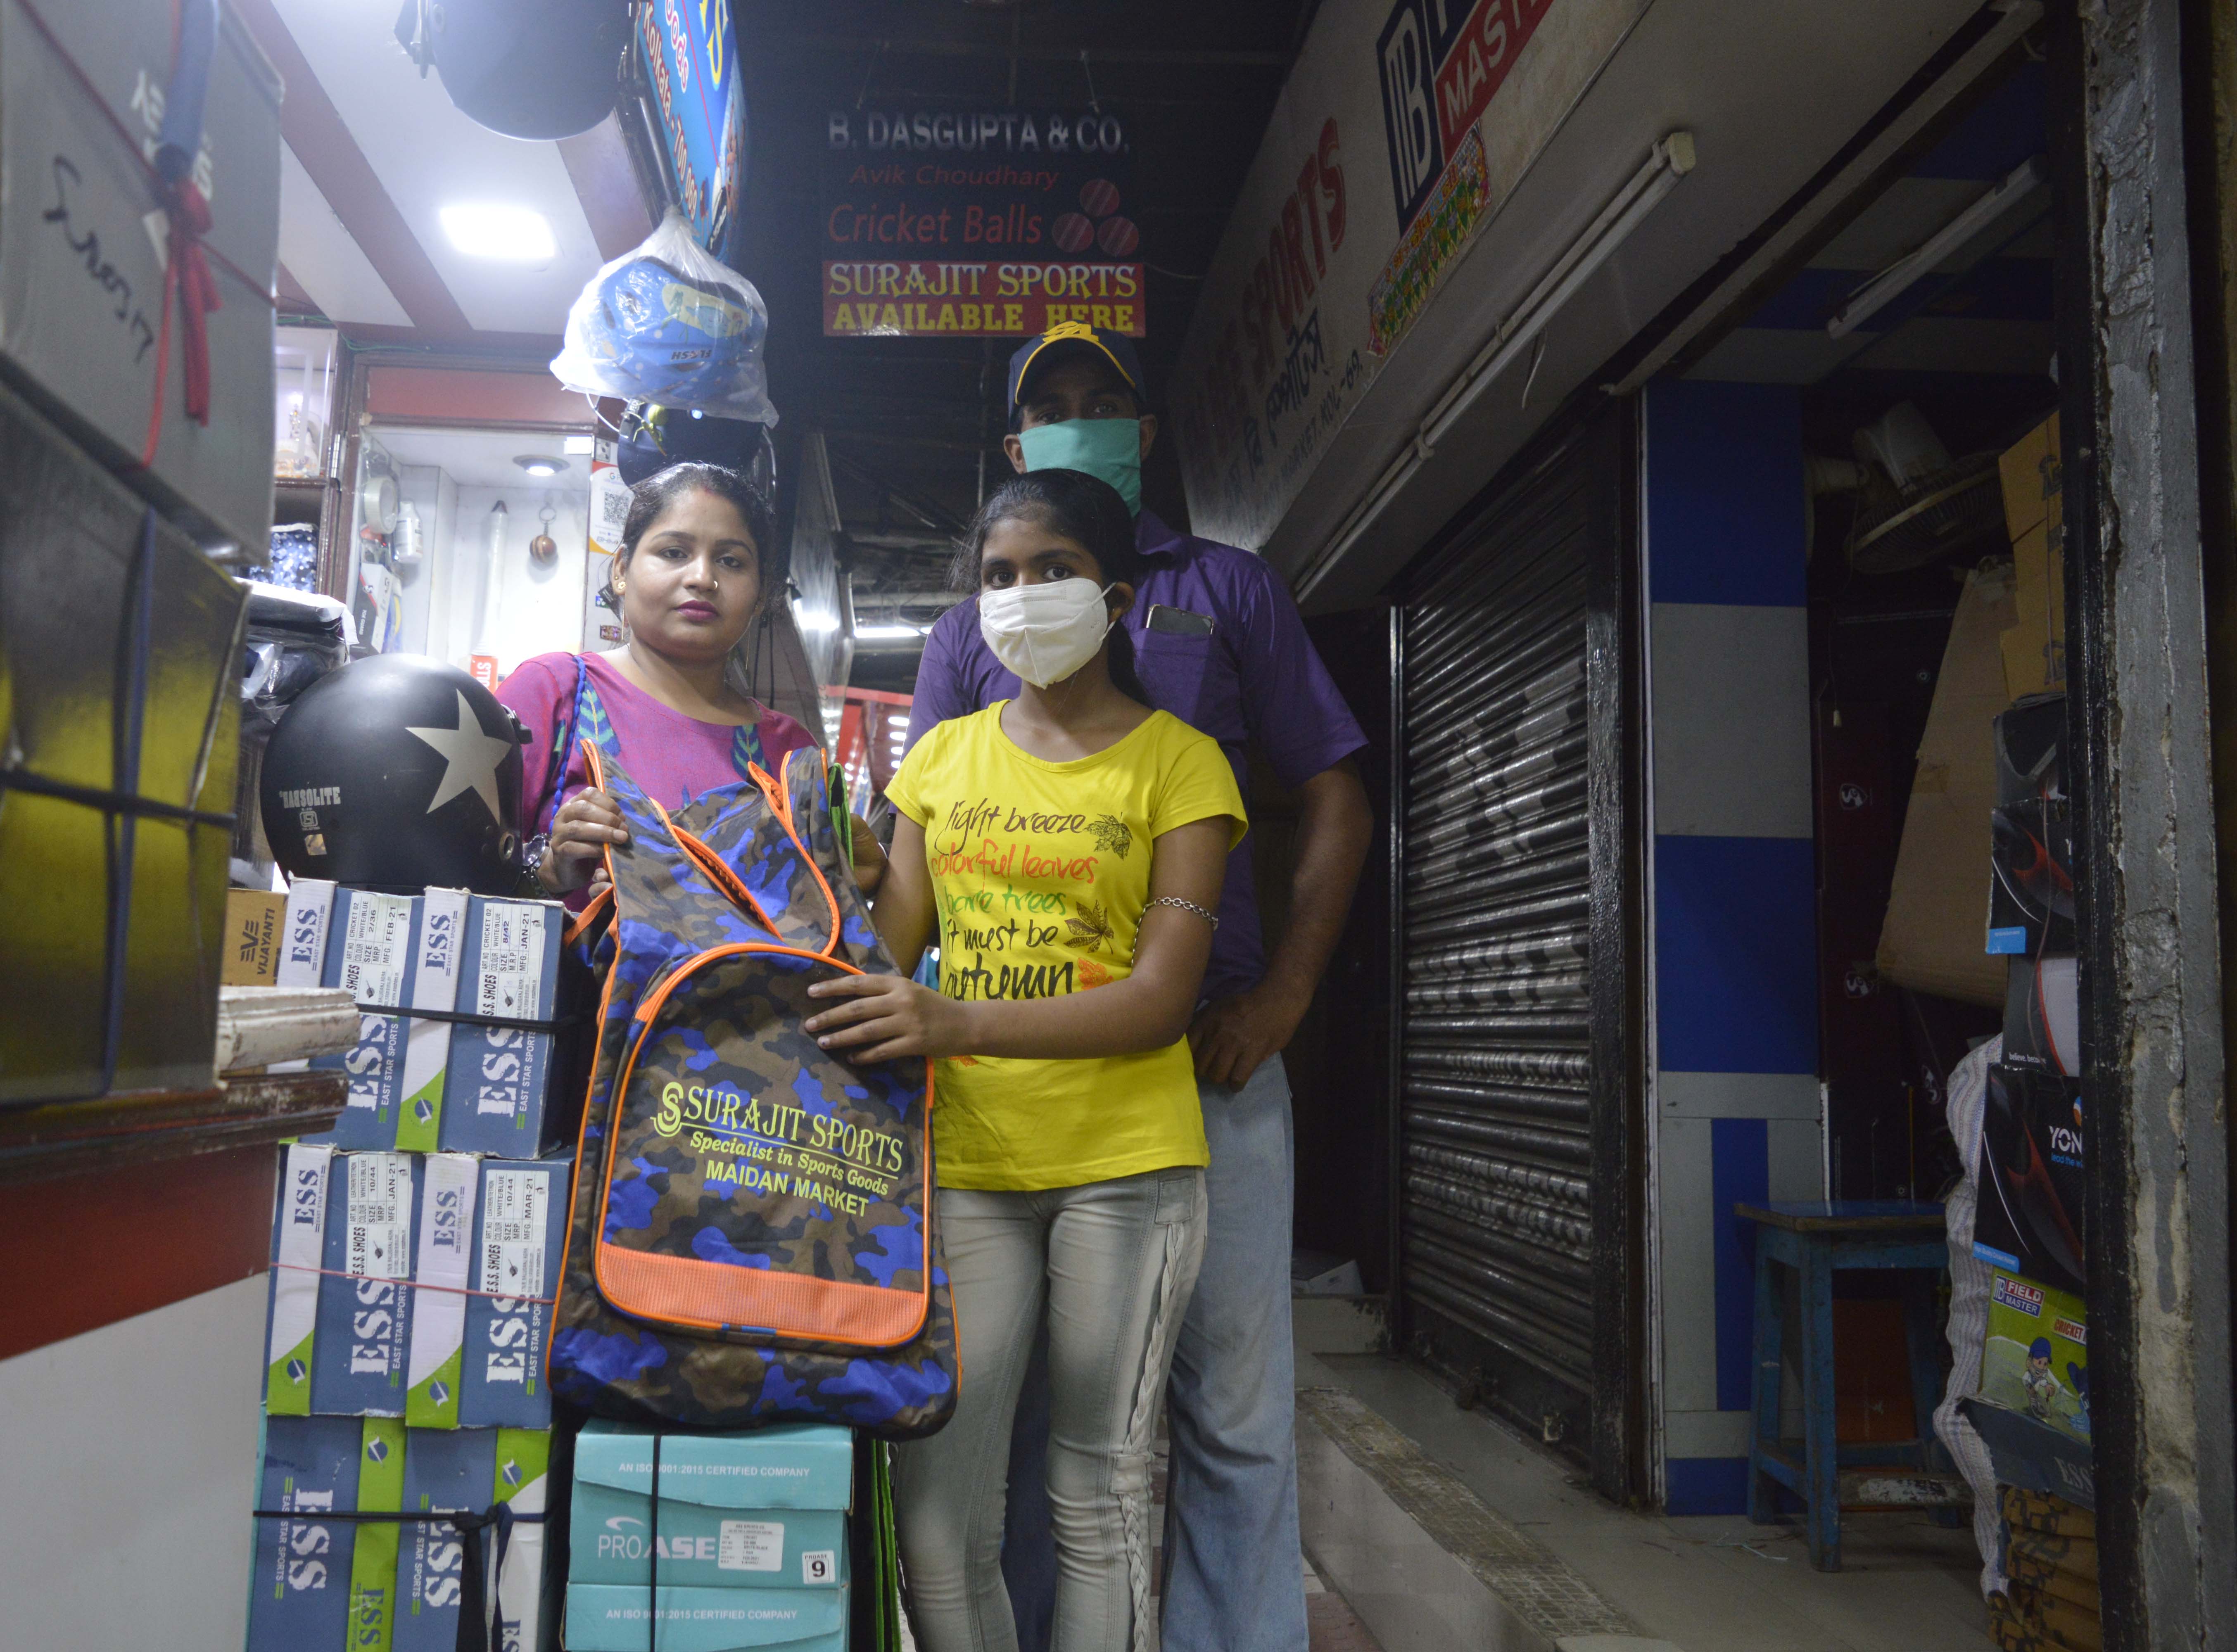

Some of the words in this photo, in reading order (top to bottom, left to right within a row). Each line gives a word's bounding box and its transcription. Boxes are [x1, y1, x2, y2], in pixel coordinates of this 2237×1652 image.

[665, 0, 689, 93] oods
[643, 0, 672, 126] Kolkata
[673, 112, 688, 185] 700
[828, 113, 857, 149] B.
[867, 112, 1040, 152] DASGUPTA
[1047, 116, 1069, 151] &
[1076, 115, 1130, 154] CO.
[849, 165, 905, 185] Avik
[916, 165, 1060, 191] Choudhary
[828, 204, 951, 243] Cricket
[963, 204, 1043, 244] Balls
[1242, 117, 1346, 381] SPORTS
[829, 263, 989, 299] SURAJIT
[997, 263, 1137, 300] SPORTS
[833, 303, 1023, 331] AVAILABLE
[934, 798, 1002, 856] light
[1003, 807, 1086, 834] breeze
[931, 838, 1016, 894] colorful
[1021, 845, 1099, 884] leaves
[944, 885, 994, 915] bare
[1001, 883, 1067, 916] trees
[349, 911, 358, 938] CRICKET
[359, 900, 369, 938] WHITE/BLUE
[368, 909, 377, 933] 2/36
[386, 907, 397, 942] FEB-21
[257, 908, 275, 975] VIJAYANTI
[291, 909, 318, 964] ESS
[425, 915, 450, 970] ESS
[947, 918, 959, 953] it
[964, 918, 1020, 952] must
[1026, 919, 1059, 948] be
[355, 943, 364, 962] COLOUR
[364, 945, 373, 963] SIZE
[373, 945, 381, 962] MRP.
[383, 946, 391, 964] MFG.
[490, 953, 499, 971] COLOUR
[519, 953, 527, 971] MFG.
[346, 964, 360, 990] SHOES
[484, 974, 497, 999] SHOES
[944, 952, 1073, 1001] autumn
[389, 1023, 399, 1056] SPORTS
[344, 1016, 387, 1112] ESS
[385, 1059, 394, 1082] STAR
[477, 1026, 525, 1118] ESS
[380, 1085, 390, 1106] EAST
[519, 1090, 529, 1112] EAST
[525, 1065, 533, 1089] STAR
[683, 1085, 806, 1141] SURAJIT
[810, 1113, 903, 1173] SPORTS
[2048, 1125, 2082, 1154] YON
[690, 1131, 774, 1162] Specialist
[777, 1148, 793, 1166] in
[797, 1153, 844, 1181] Sports
[847, 1170, 889, 1195] Goods
[294, 1170, 318, 1226] ESS
[706, 1160, 789, 1194] MAIDAN
[793, 1178, 869, 1217] MARKET
[433, 1190, 457, 1248] ESS
[494, 1222, 503, 1241] COLOUR
[524, 1221, 532, 1240] MFG.
[353, 1226, 366, 1253] SHOES
[488, 1243, 501, 1270] SHOES
[397, 1284, 407, 1319] SPORTS
[2005, 1295, 2038, 1314] MASTER
[2007, 1281, 2042, 1303] FIELD
[350, 1277, 395, 1376] ESS
[395, 1322, 404, 1344] STAR
[531, 1329, 540, 1352] STAR
[2054, 1318, 2084, 1339] CRICKET
[392, 1348, 402, 1370] EAST
[528, 1355, 537, 1377] EAST
[619, 1463, 633, 1472] AN
[636, 1463, 653, 1473] ISO
[705, 1466, 758, 1476] CERTIFIED
[760, 1467, 810, 1477] COMPANY
[279, 1521, 288, 1543] STAR
[288, 1488, 333, 1591] ESS
[275, 1545, 286, 1581] SPORTS
[416, 1537, 425, 1560] STAR
[412, 1563, 423, 1597] SPORTS
[811, 1560, 826, 1578] 9
[359, 1588, 385, 1646] ESS
[606, 1610, 620, 1619] AN
[623, 1610, 640, 1619] ISO
[693, 1611, 745, 1620] CERTIFIED
[747, 1611, 797, 1620] COMPANY
